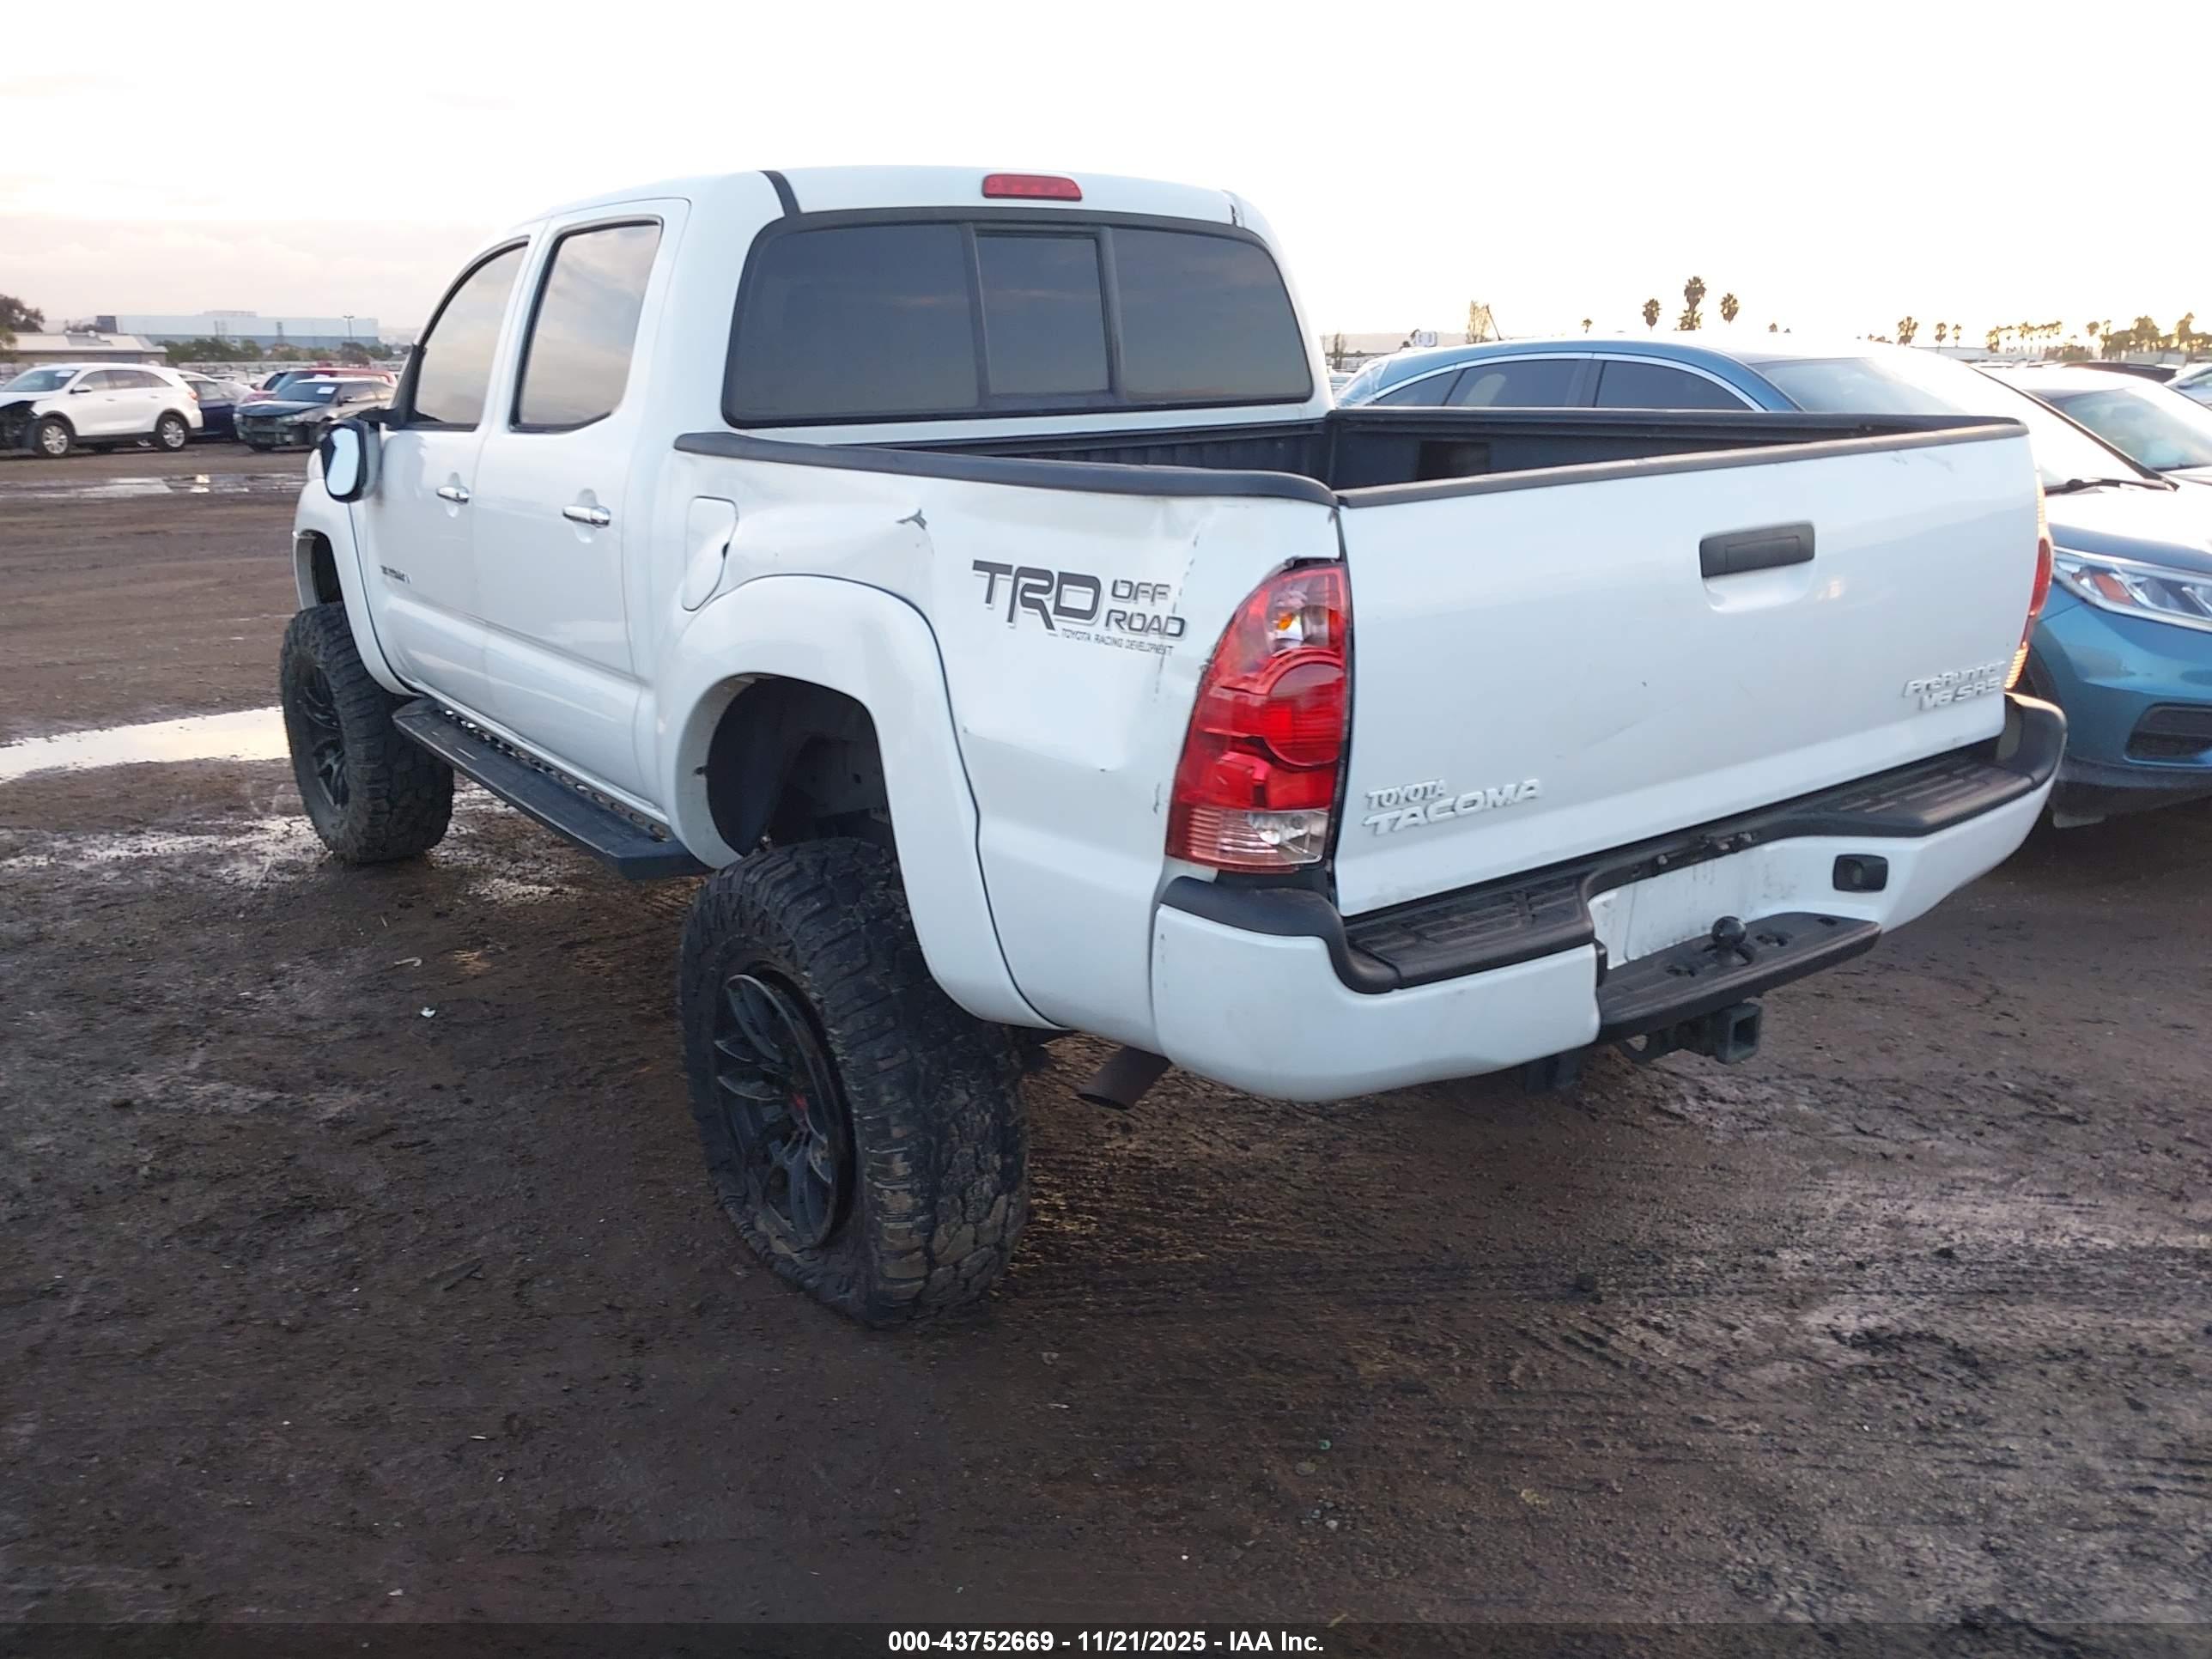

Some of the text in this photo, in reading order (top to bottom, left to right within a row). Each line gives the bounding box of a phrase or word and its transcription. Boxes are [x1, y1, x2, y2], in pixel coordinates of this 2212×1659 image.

[972, 559, 1101, 630] TRD
[1111, 579, 1170, 603] OFF
[1105, 609, 1185, 638] ROAD
[1363, 778, 1542, 836] TACOMA
[1366, 779, 1446, 810] TOYOTA
